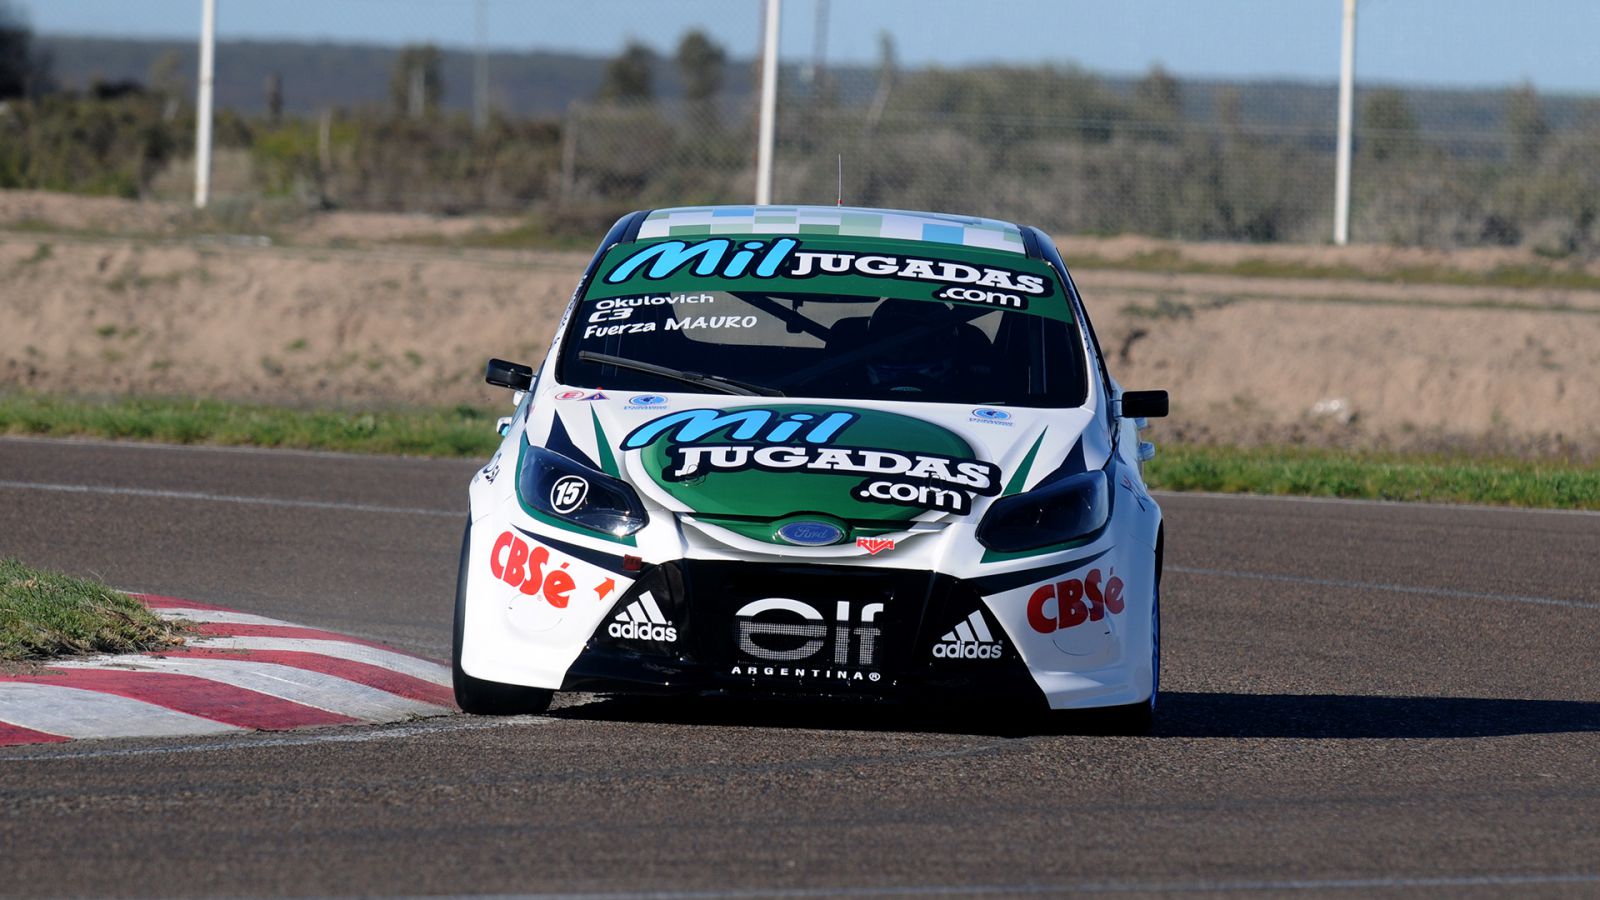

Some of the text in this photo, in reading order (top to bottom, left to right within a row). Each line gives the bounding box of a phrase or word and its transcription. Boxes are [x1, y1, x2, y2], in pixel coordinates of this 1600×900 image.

[608, 238, 1045, 294] Mil JUGADAS
[595, 294, 714, 311] Okulovich
[940, 288, 1021, 307] .com
[584, 315, 757, 339] Fuerza MAURO
[588, 308, 634, 323] C3
[626, 410, 853, 448] Mil
[675, 446, 990, 489] JUGADAS
[556, 481, 584, 506] 15
[860, 481, 962, 510] .com
[794, 526, 828, 539] Ford
[856, 538, 895, 555] RIVA
[490, 531, 576, 609] CBSé
[1027, 566, 1125, 634] CBSé
[608, 621, 677, 642] adidas
[932, 640, 1002, 659] adidas
